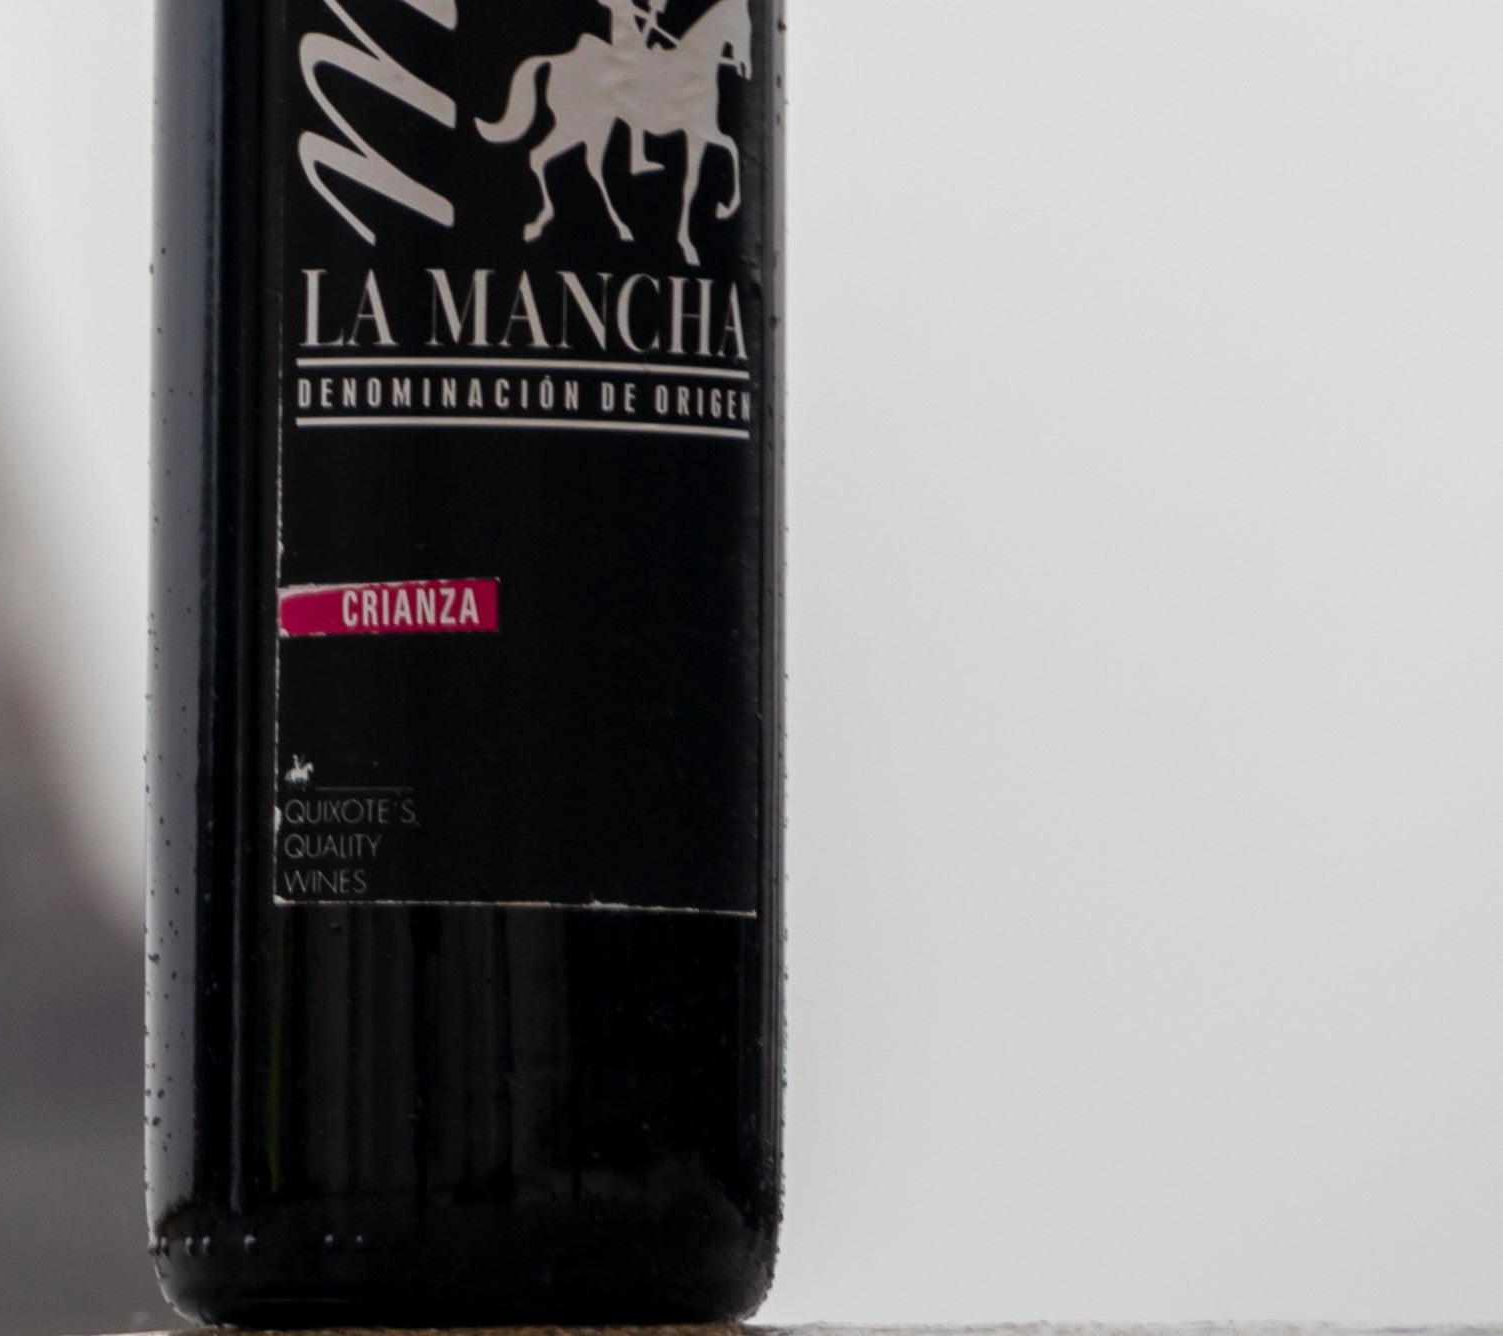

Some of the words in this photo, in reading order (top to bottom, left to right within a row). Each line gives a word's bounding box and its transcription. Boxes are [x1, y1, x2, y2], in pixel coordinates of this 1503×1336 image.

[299, 268, 399, 348] LA
[425, 268, 749, 361] MANCHA
[296, 375, 580, 411] DENOMINACIÓN
[600, 381, 637, 414] DE
[654, 384, 751, 422] ORIGEN
[342, 588, 479, 627] CRIANZA
[284, 798, 416, 824] QUIXOTE'S
[284, 833, 382, 859] QUALITY
[284, 869, 368, 895] WINES
